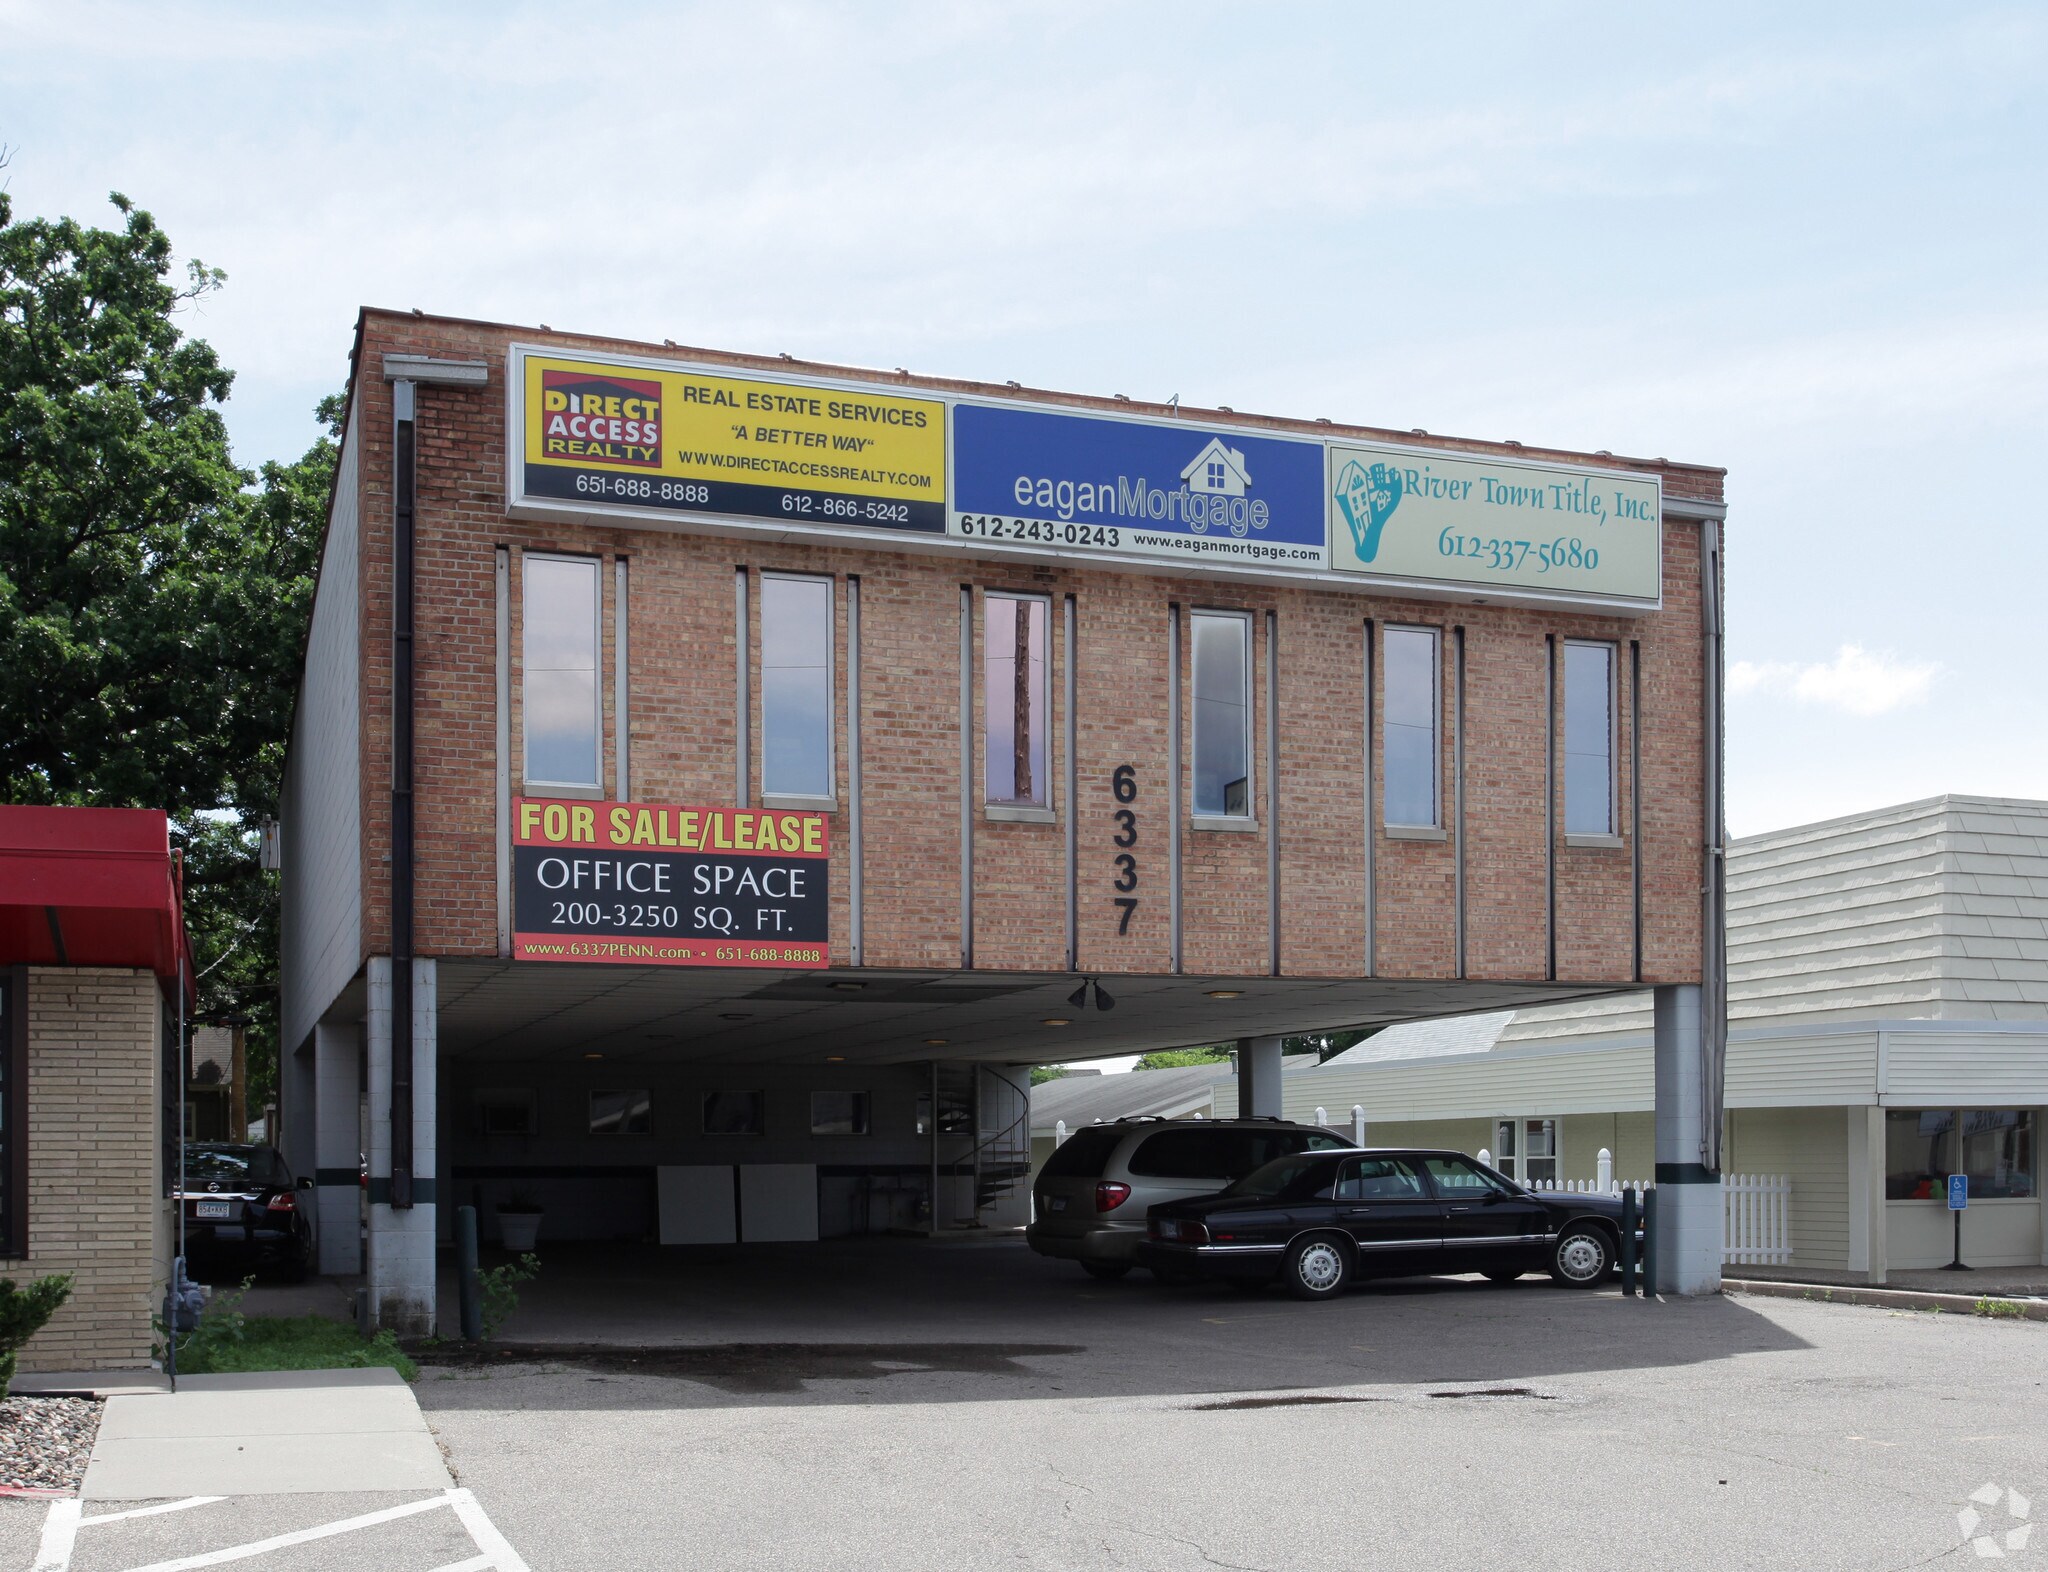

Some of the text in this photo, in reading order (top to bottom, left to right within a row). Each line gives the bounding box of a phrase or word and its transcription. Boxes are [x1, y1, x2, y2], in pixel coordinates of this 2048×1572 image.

[545, 390, 659, 422] DIRECT
[684, 386, 927, 428] REAL ESTATE SERVICES
[547, 415, 658, 445] ACCESS
[755, 427, 827, 449] BETTER
[548, 439, 656, 461] REALTY
[678, 450, 931, 488] WWW.DIRECTACCESSREALTY.COM
[576, 475, 709, 503] 651-688-8888
[1403, 466, 1656, 526] River Town Title, Inc.
[782, 495, 908, 522] 612-866-5242
[1014, 475, 1269, 537] eaganMortgage
[961, 515, 1120, 547] 612-243-0243
[1134, 533, 1321, 561] www.eaganmortgage.com
[1439, 526, 1599, 572] 612-337-5680
[520, 803, 822, 853] FOR SALE/LEASE
[537, 858, 806, 898] OFFICE SPACE
[551, 902, 793, 935] 200-3250 SQ. FT.
[524, 942, 820, 963] www.6337PENN.com 651-688-8888
